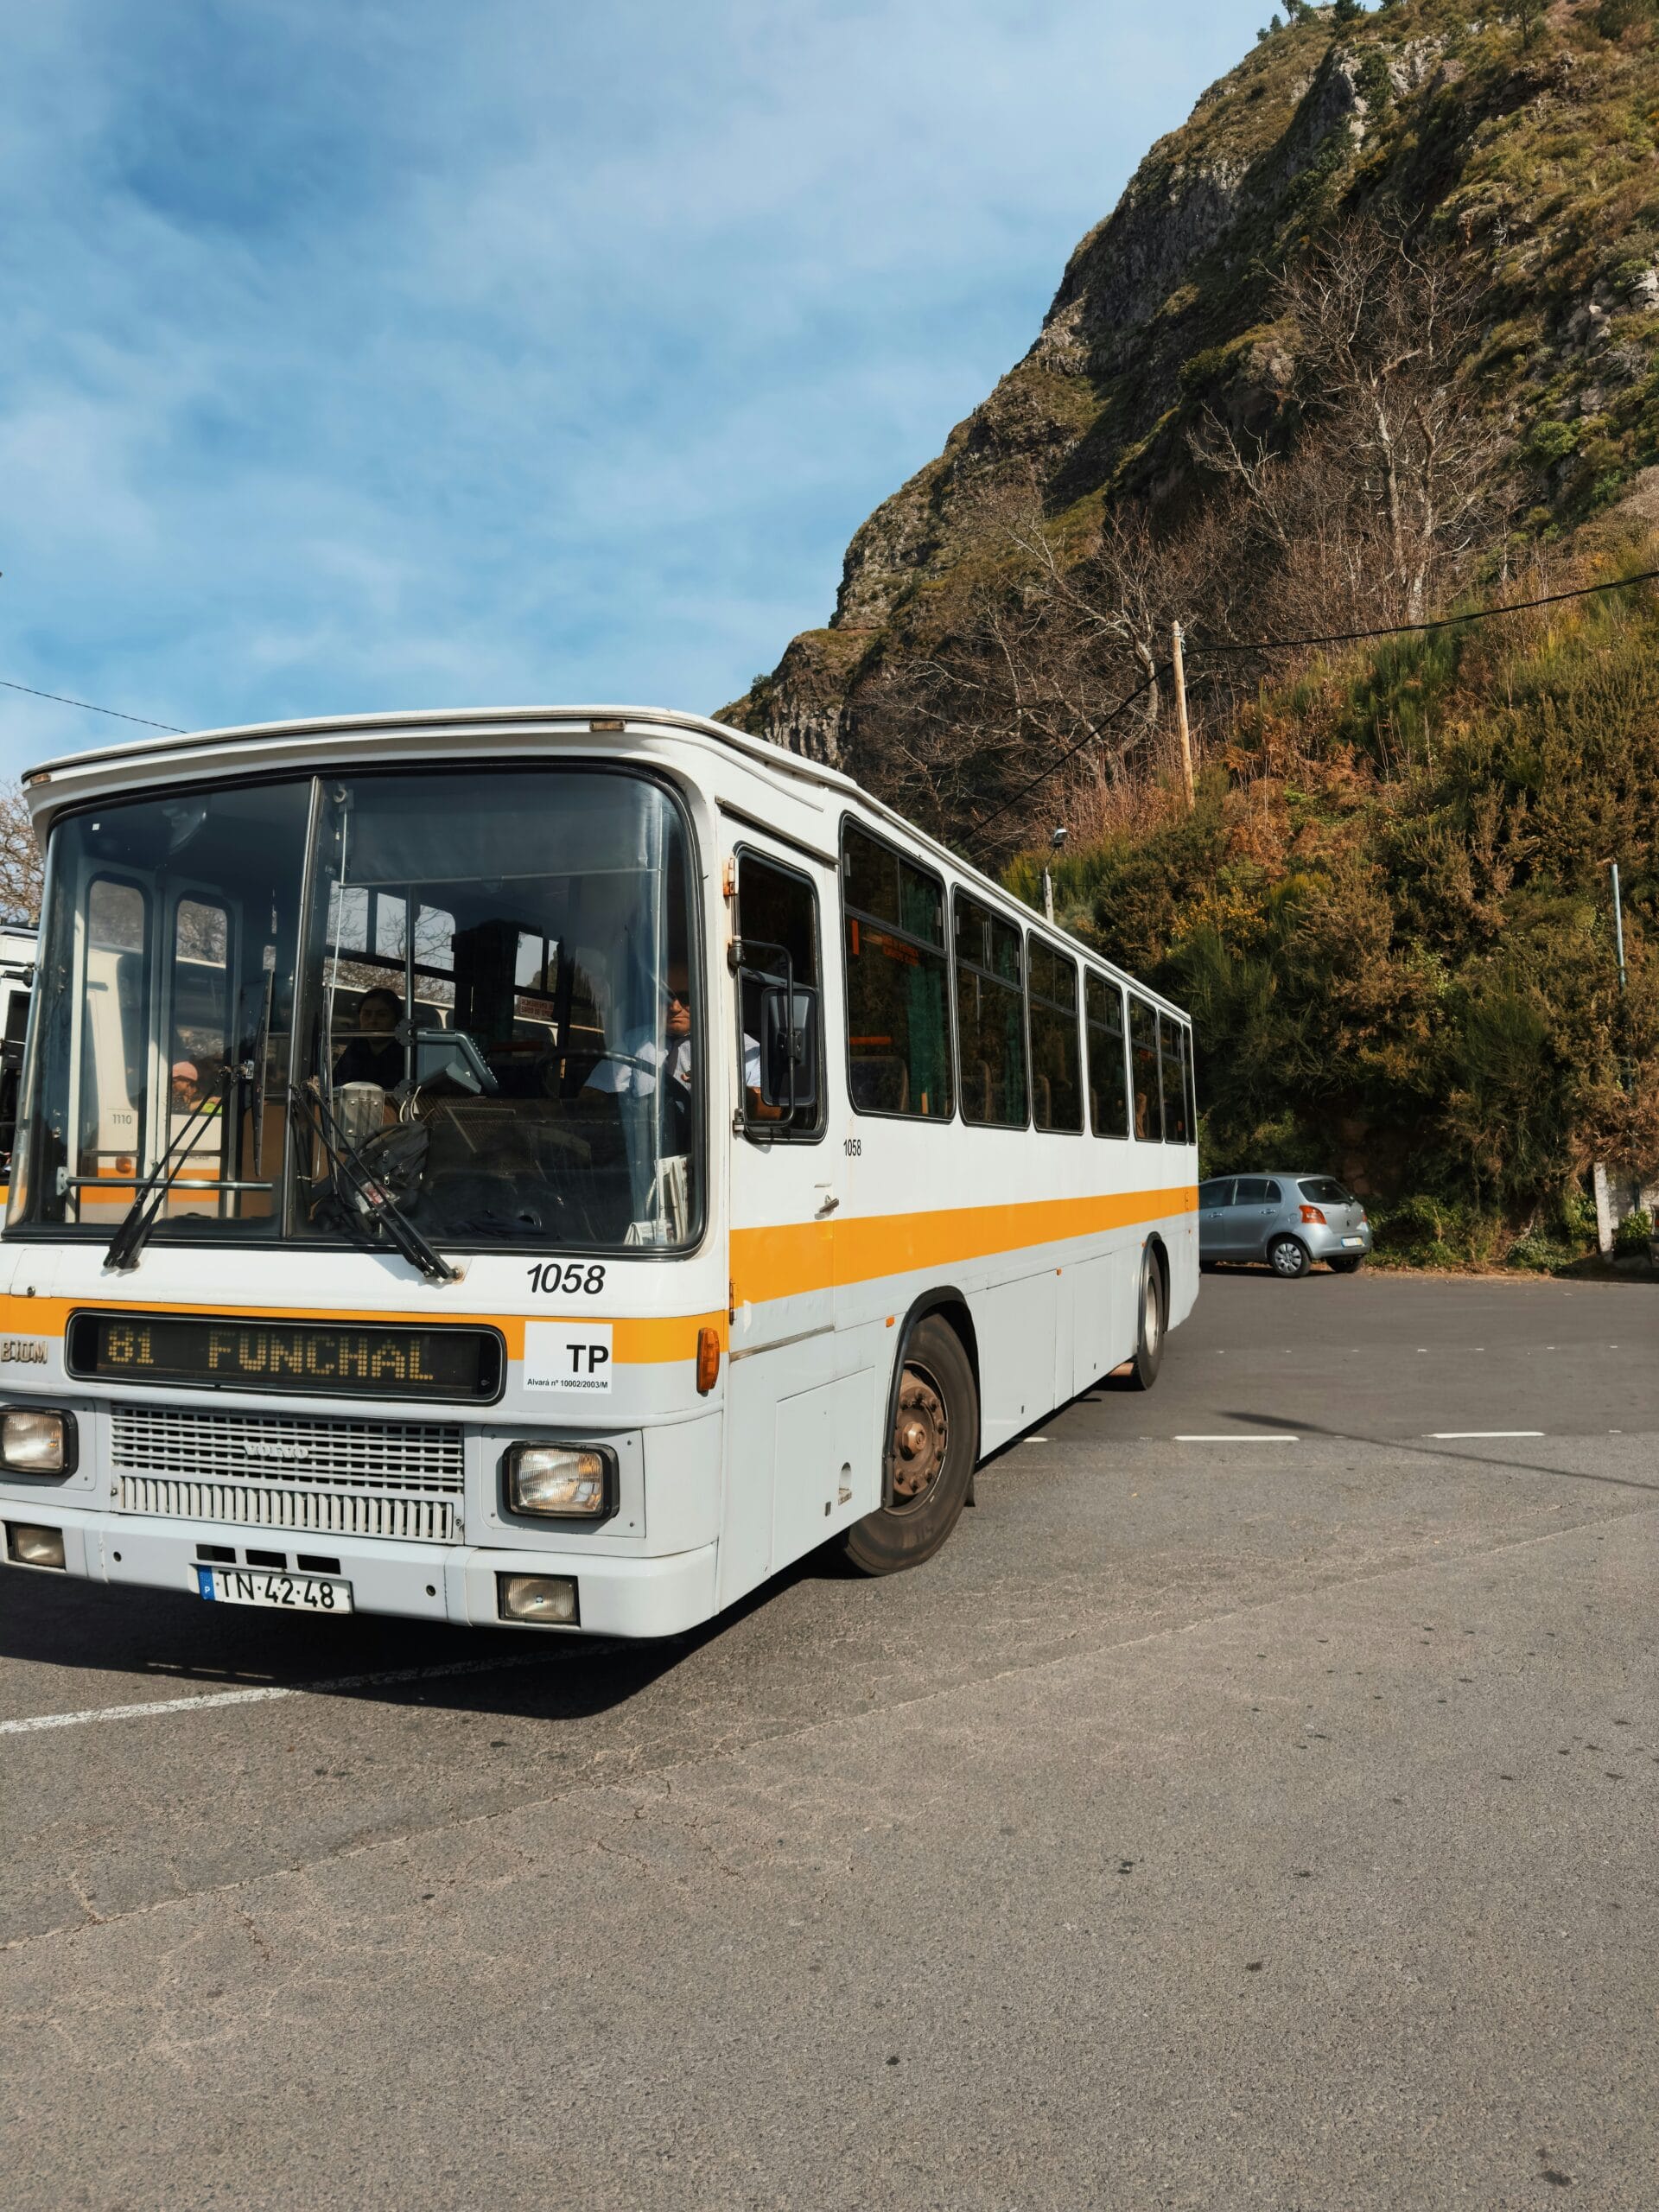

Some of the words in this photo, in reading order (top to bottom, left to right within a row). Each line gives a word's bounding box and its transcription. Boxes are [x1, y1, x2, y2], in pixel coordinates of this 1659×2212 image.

[112, 1114, 132, 1125] 1110
[843, 1139, 861, 1156] 1058
[527, 1263, 606, 1294] 1058
[108, 1326, 154, 1364] 81
[208, 1331, 433, 1381] FUNCHAL
[566, 1344, 609, 1373] TP
[527, 1378, 550, 1387] Alvará
[561, 1380, 608, 1389] 10002/2003/M
[244, 1441, 309, 1459] VOLVO
